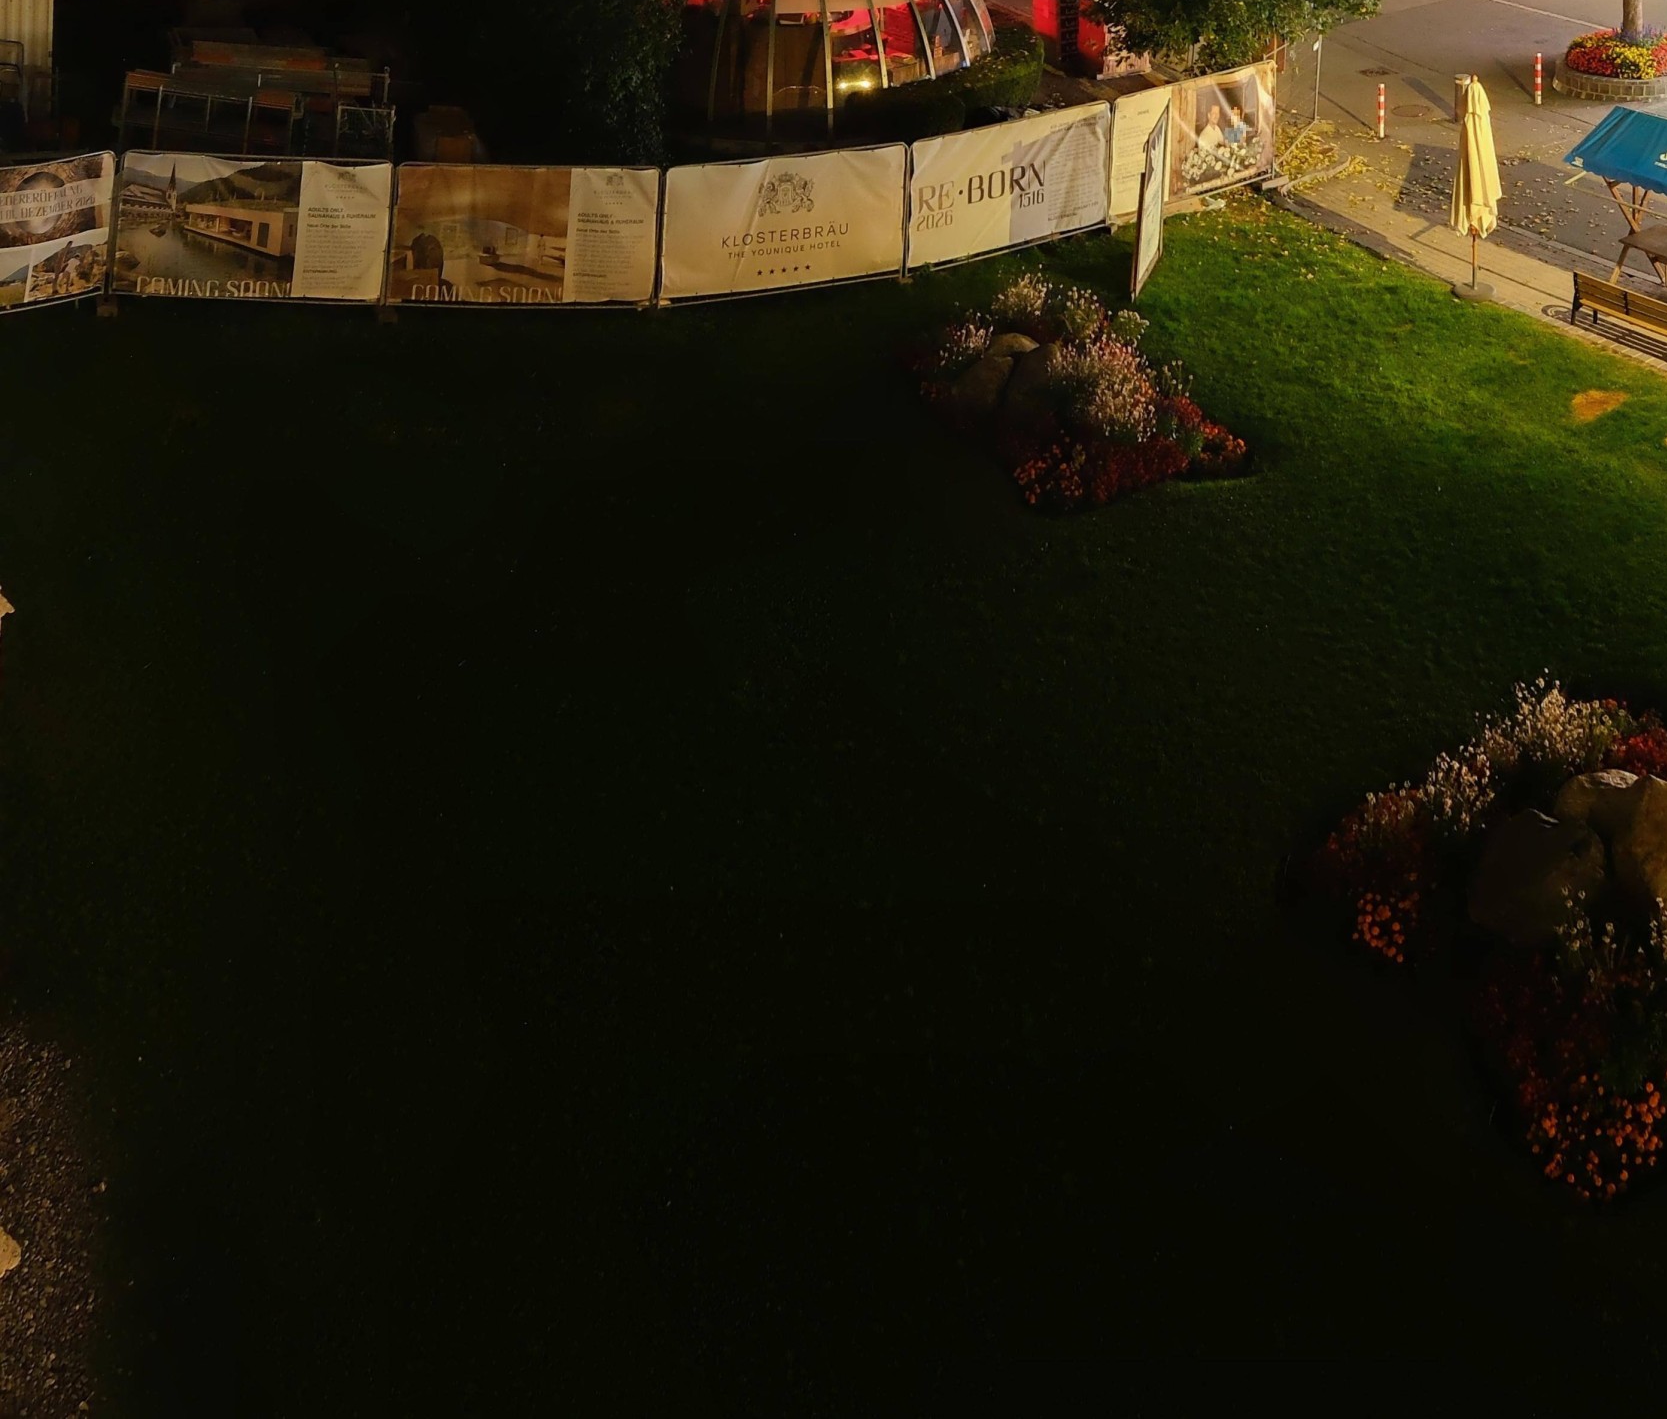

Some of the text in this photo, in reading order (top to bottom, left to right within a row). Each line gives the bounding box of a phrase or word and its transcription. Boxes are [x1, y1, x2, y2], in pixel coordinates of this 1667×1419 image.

[1019, 189, 1045, 209] 1516
[916, 209, 953, 232] 2026
[721, 221, 850, 250] KLOSTERBRÄU
[728, 240, 841, 260] THE YOUNIQUE HOTEL
[136, 276, 292, 298] COMING SOON!
[411, 283, 563, 303] COMING SOON!
